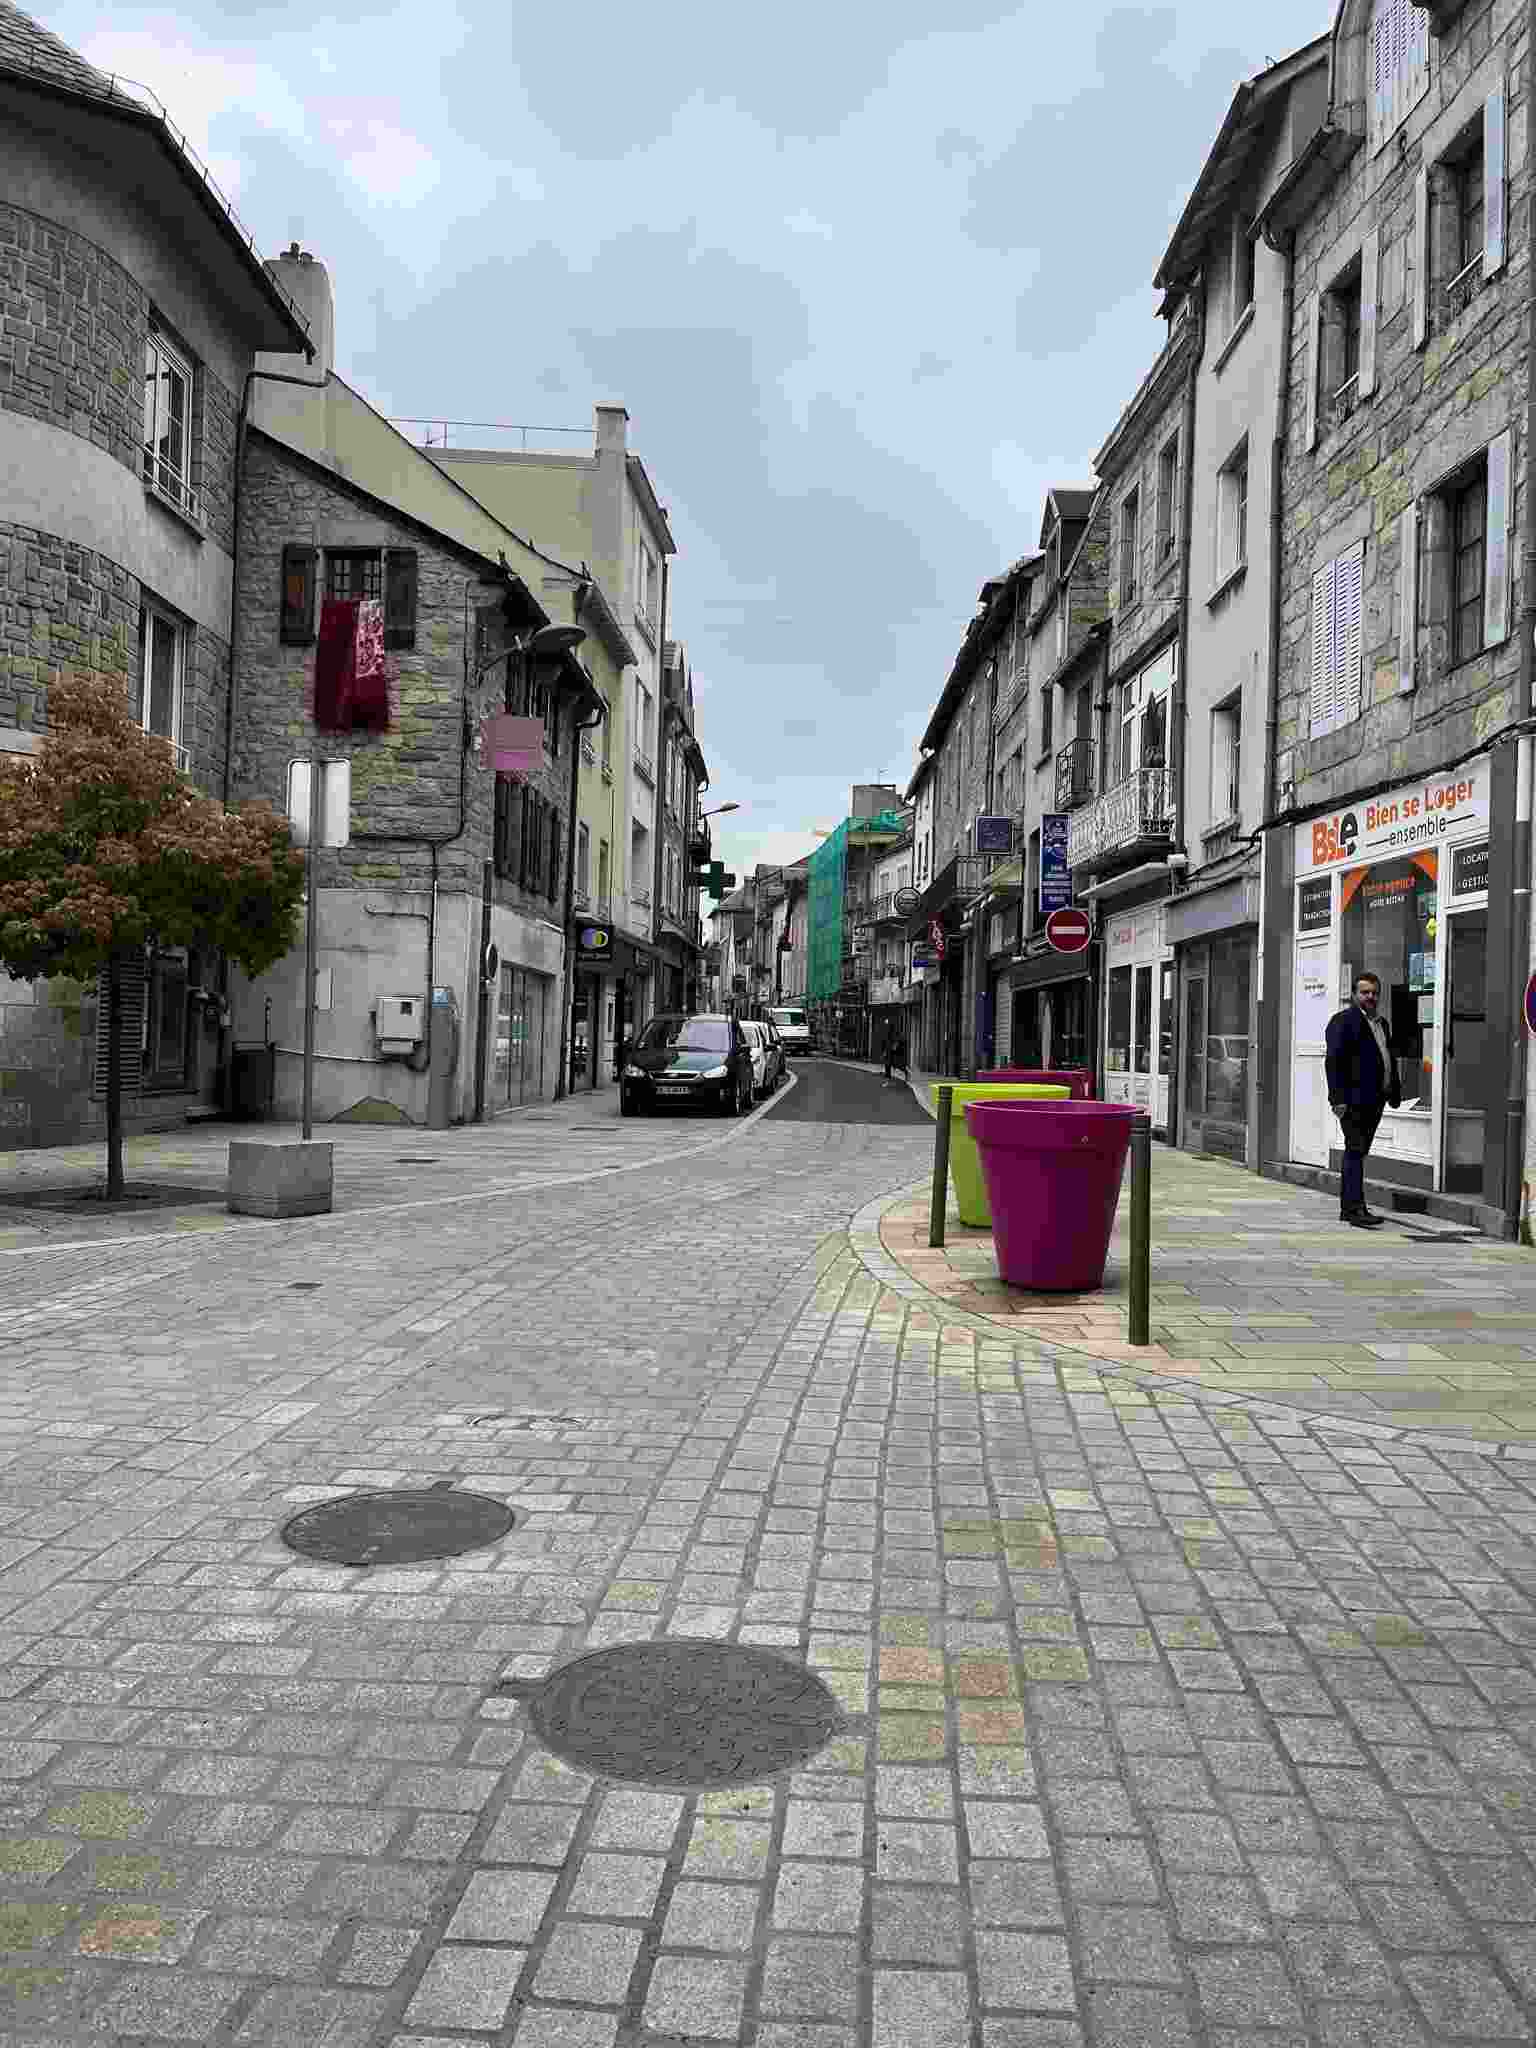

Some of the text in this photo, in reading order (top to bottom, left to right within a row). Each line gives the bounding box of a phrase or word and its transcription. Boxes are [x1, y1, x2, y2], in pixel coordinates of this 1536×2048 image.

[1366, 779, 1475, 831] Bien se Loger
[1390, 815, 1446, 845] ensemble
